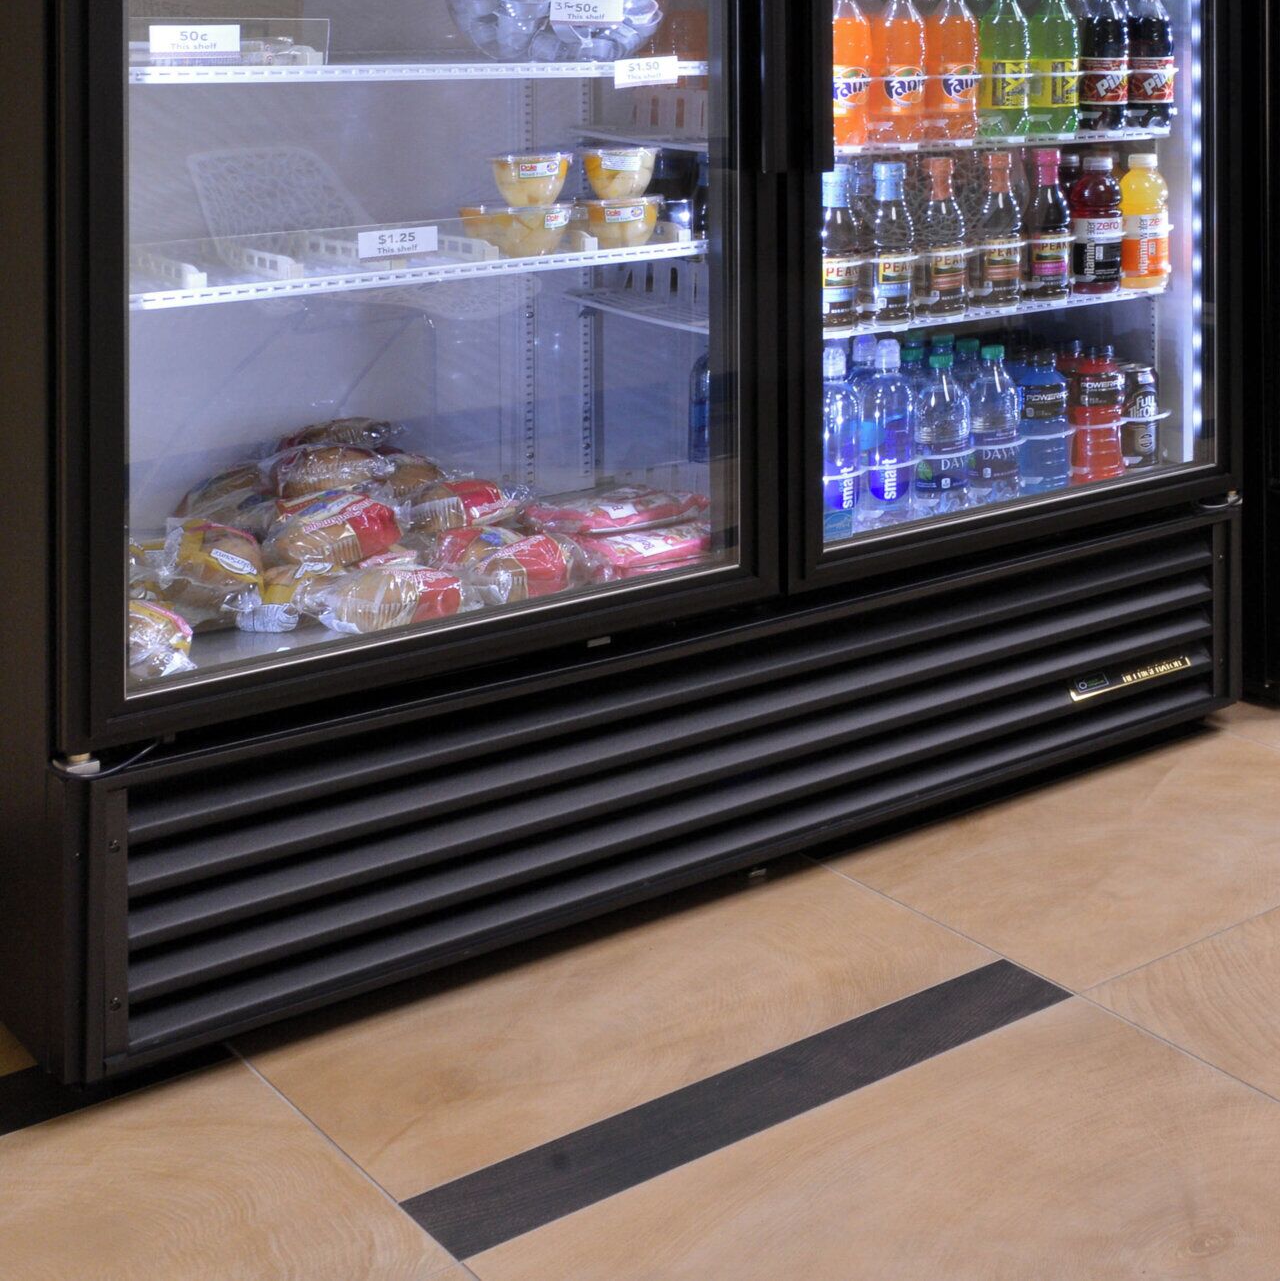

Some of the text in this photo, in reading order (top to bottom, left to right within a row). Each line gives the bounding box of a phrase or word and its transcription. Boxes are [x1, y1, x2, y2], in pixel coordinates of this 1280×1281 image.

[171, 42, 217, 50] This shelf
[1097, 220, 1119, 230] zero
[378, 231, 416, 245] $1.25
[377, 243, 418, 254] This shelf
